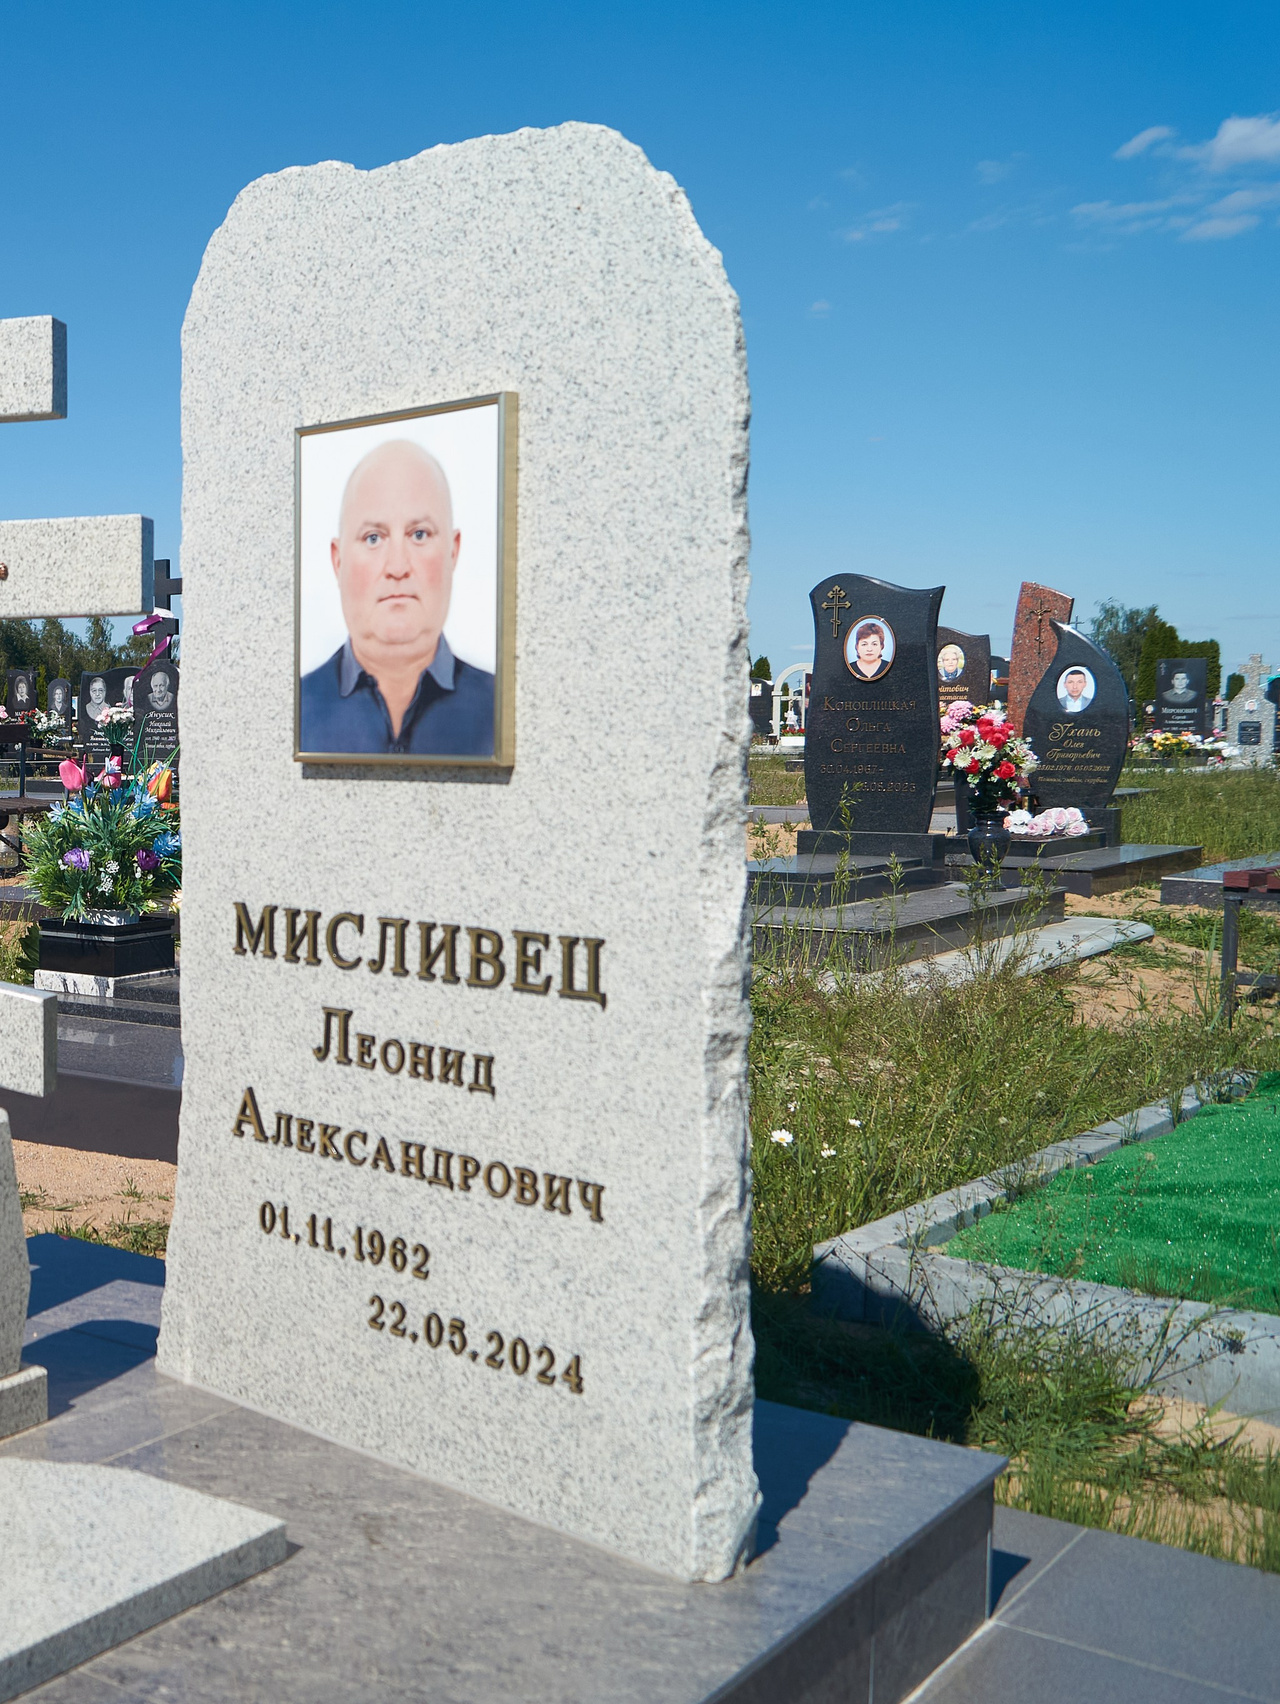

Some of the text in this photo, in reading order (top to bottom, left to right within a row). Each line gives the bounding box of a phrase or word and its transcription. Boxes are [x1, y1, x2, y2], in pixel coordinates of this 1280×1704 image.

[1048, 722, 1102, 742] Ухань
[232, 902, 607, 1010] МИСЛИВЕЦ
[259, 1200, 431, 1280] 01.11.1962
[367, 1295, 585, 1395] 22.05.2024
